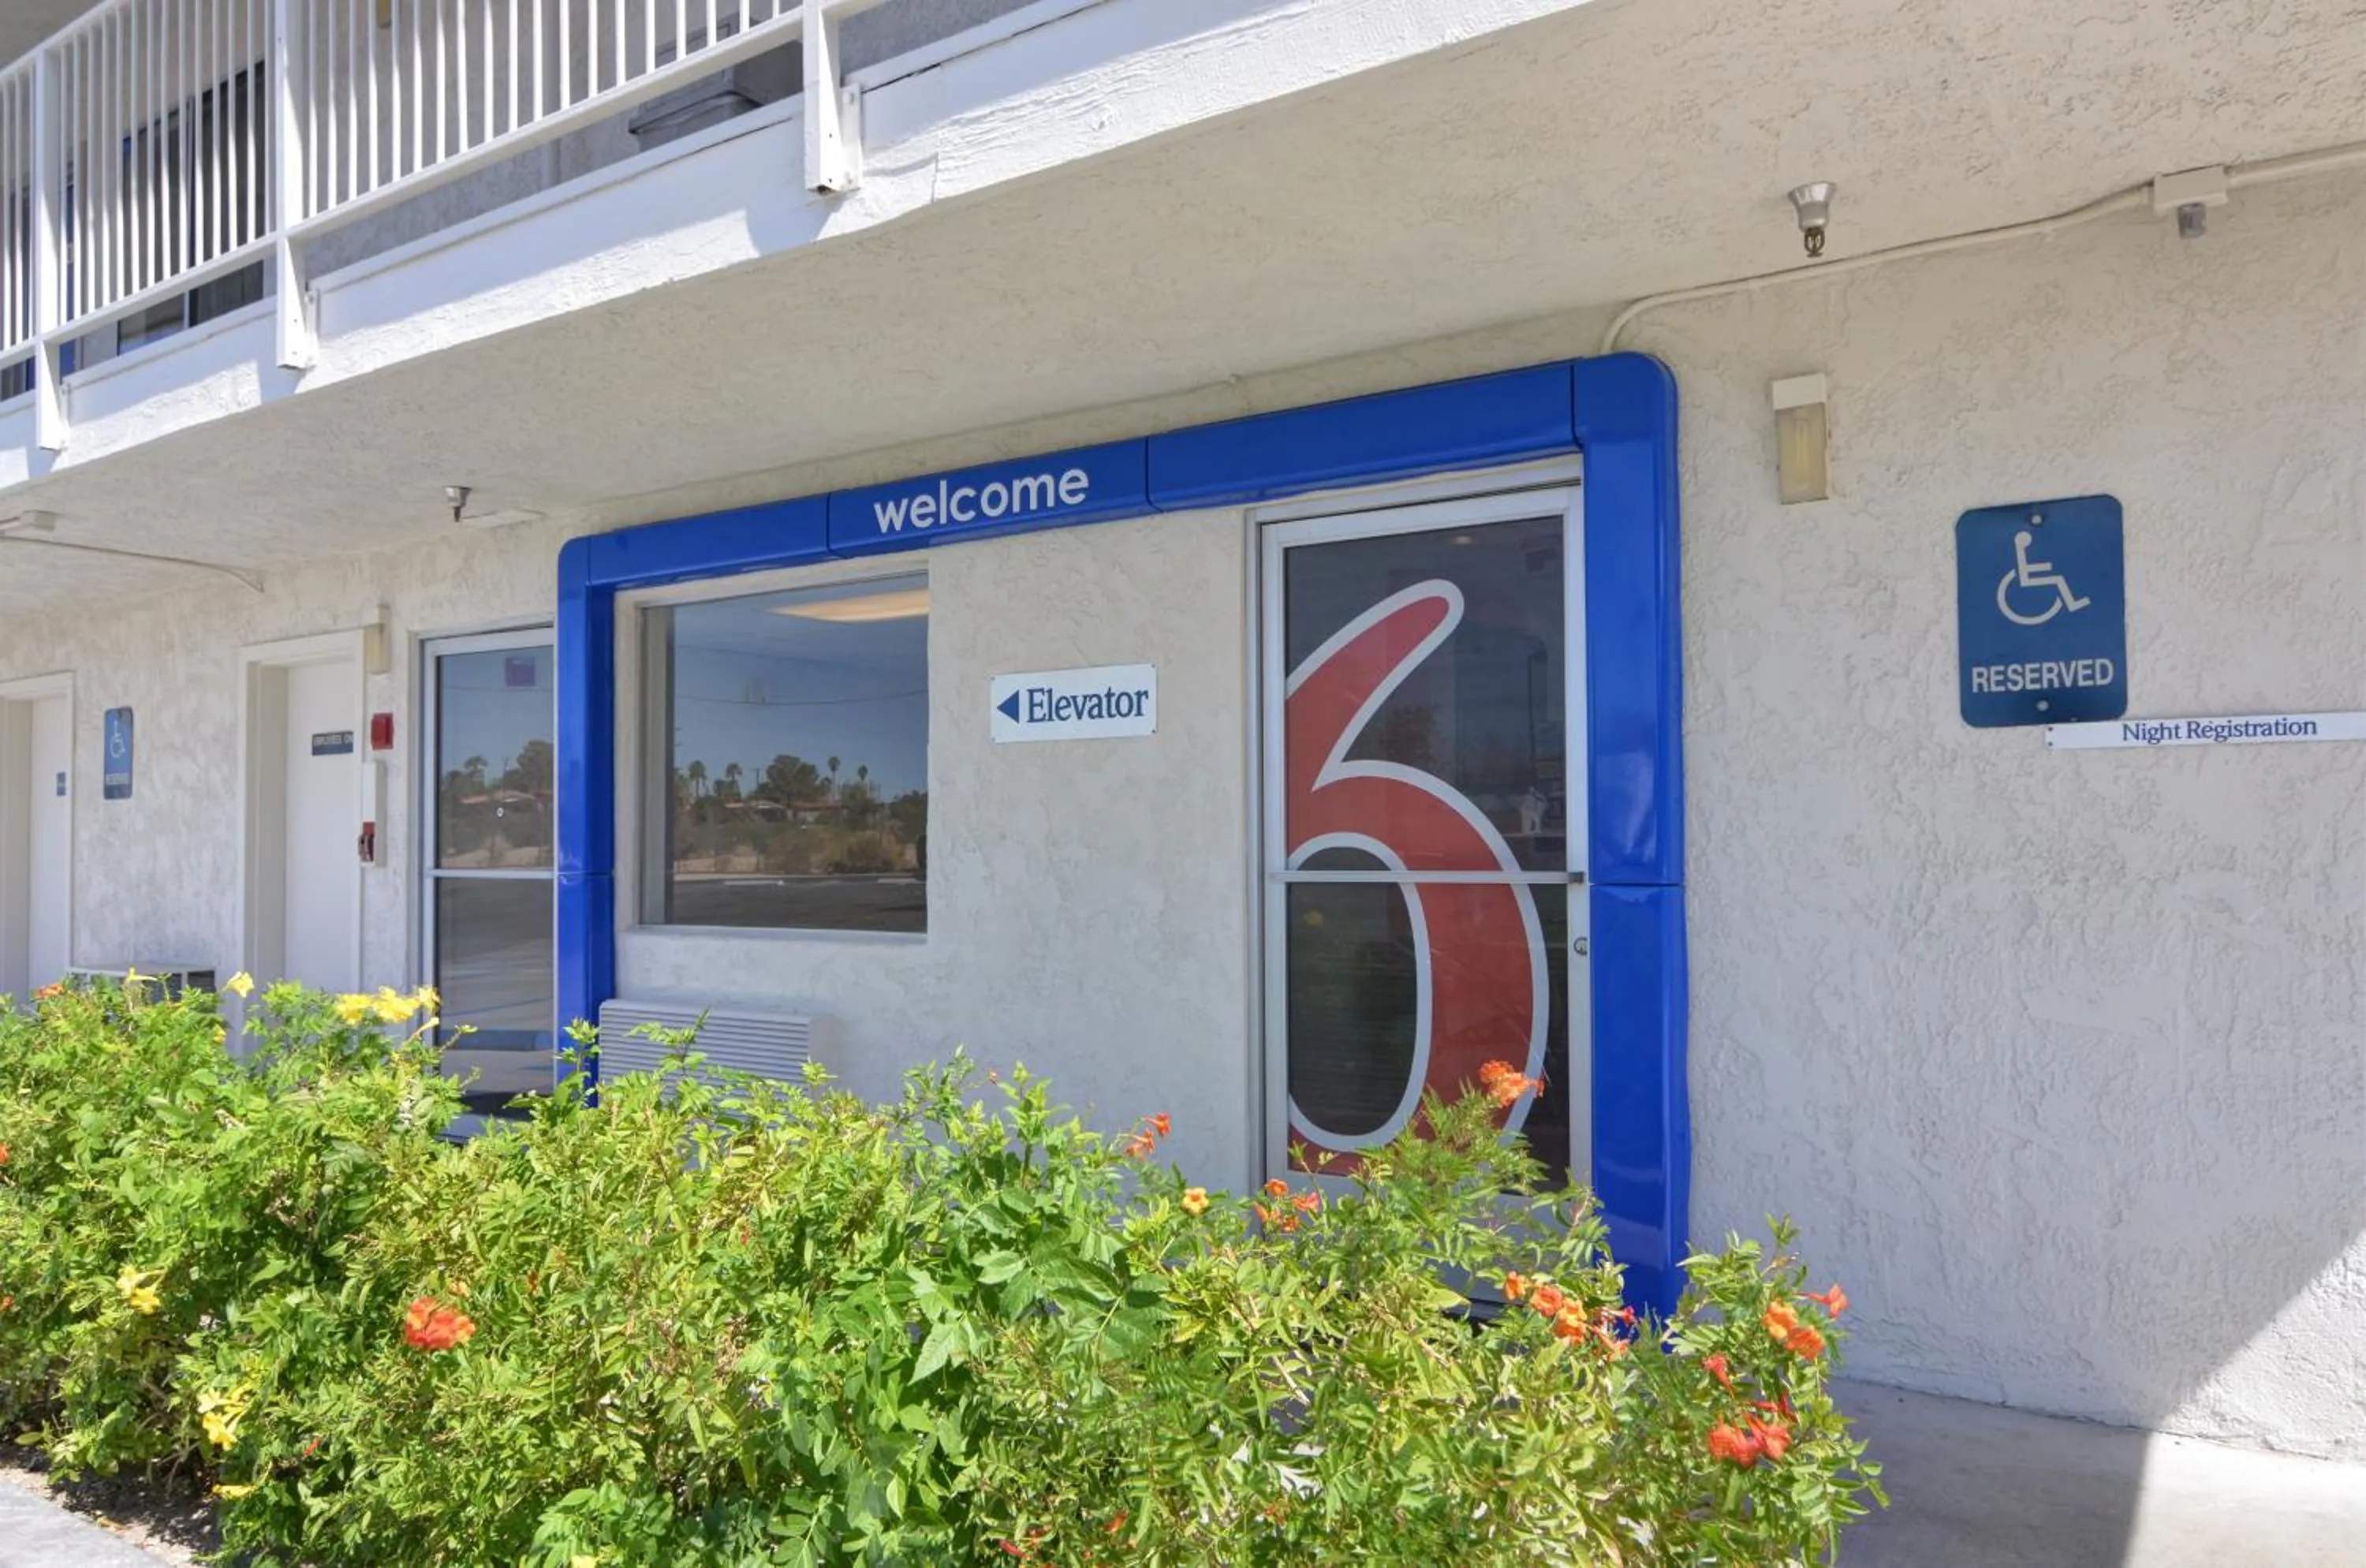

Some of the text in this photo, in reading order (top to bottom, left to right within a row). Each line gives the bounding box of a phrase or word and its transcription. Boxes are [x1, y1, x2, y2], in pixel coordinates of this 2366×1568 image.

[873, 468, 1089, 534] welcome
[1972, 658, 2114, 693] RESERVED
[1025, 686, 1149, 723] Elevator
[2122, 716, 2318, 745] Night Registration
[1286, 578, 1550, 1175] 6
